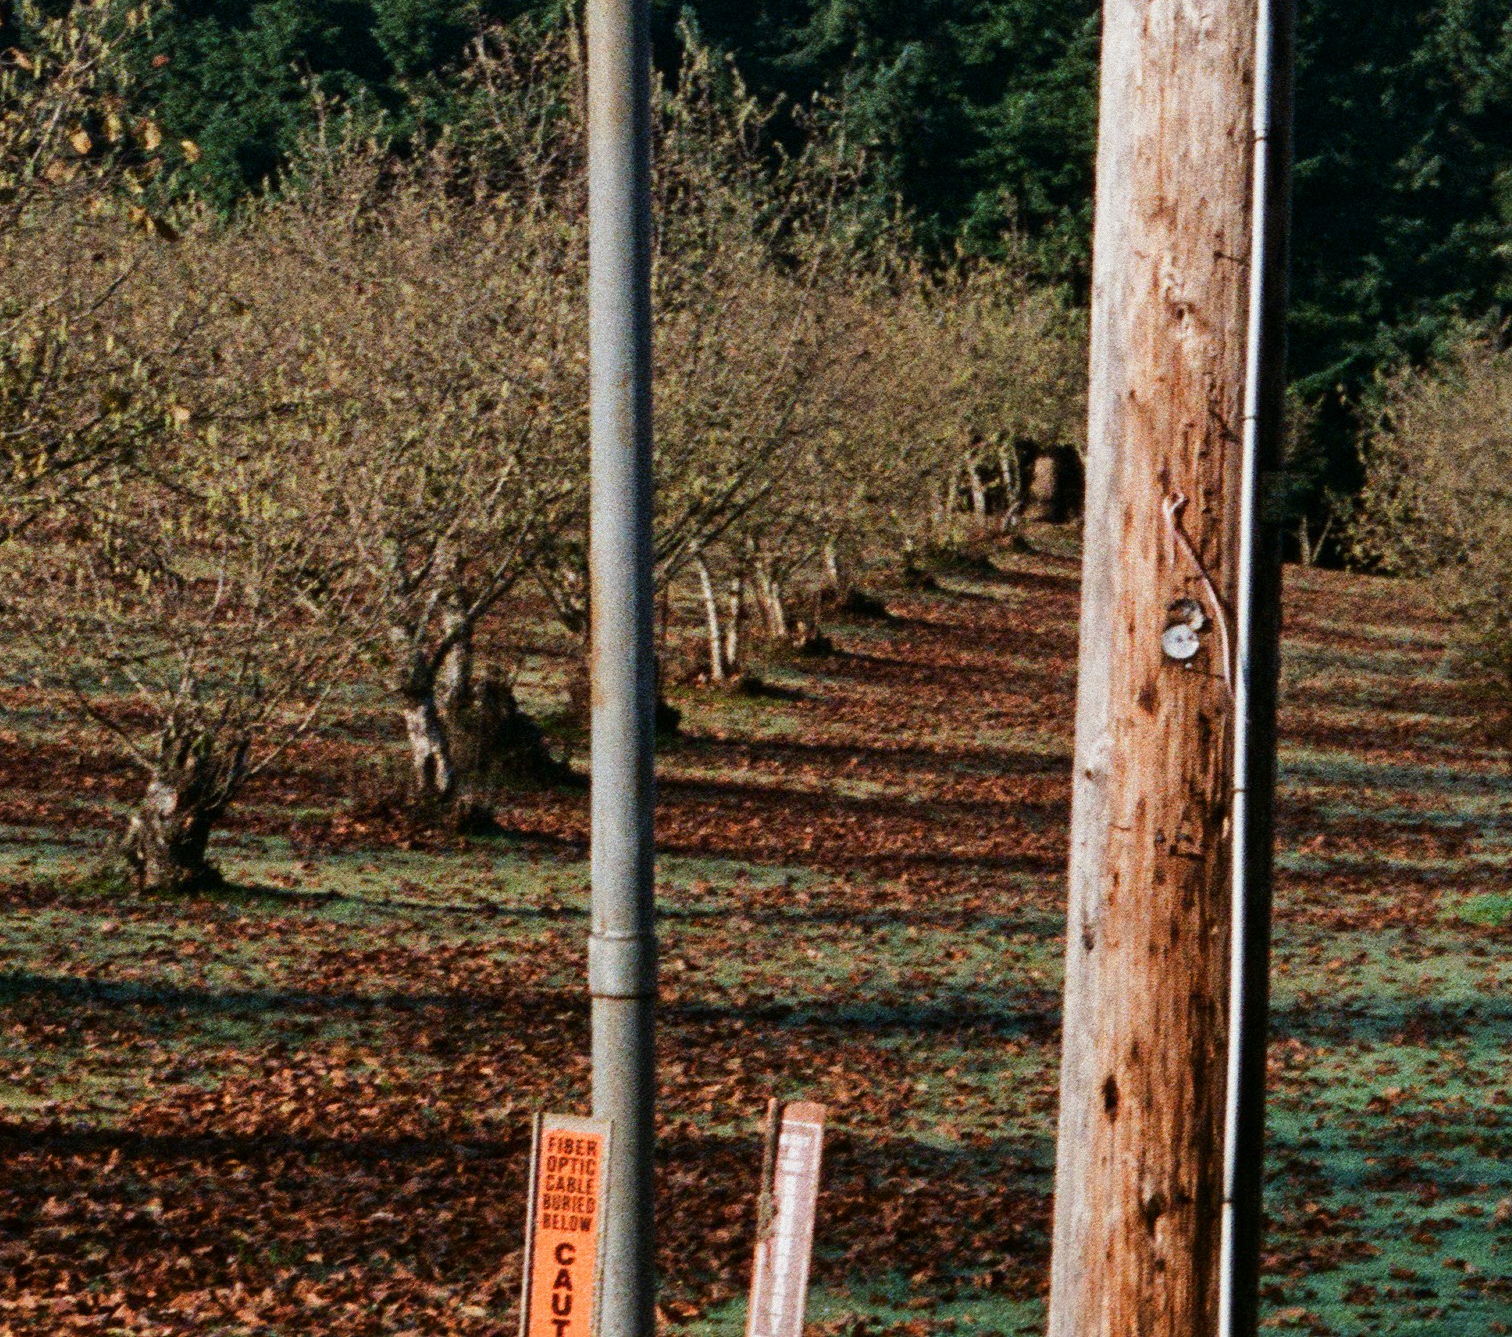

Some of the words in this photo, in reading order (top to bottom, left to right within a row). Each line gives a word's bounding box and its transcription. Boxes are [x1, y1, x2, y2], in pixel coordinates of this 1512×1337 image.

[547, 1137, 597, 1155] FIBER
[546, 1156, 596, 1175] OPTIC
[544, 1175, 595, 1195] CABLE
[543, 1193, 596, 1214] BURIED
[542, 1213, 592, 1232] BELOW
